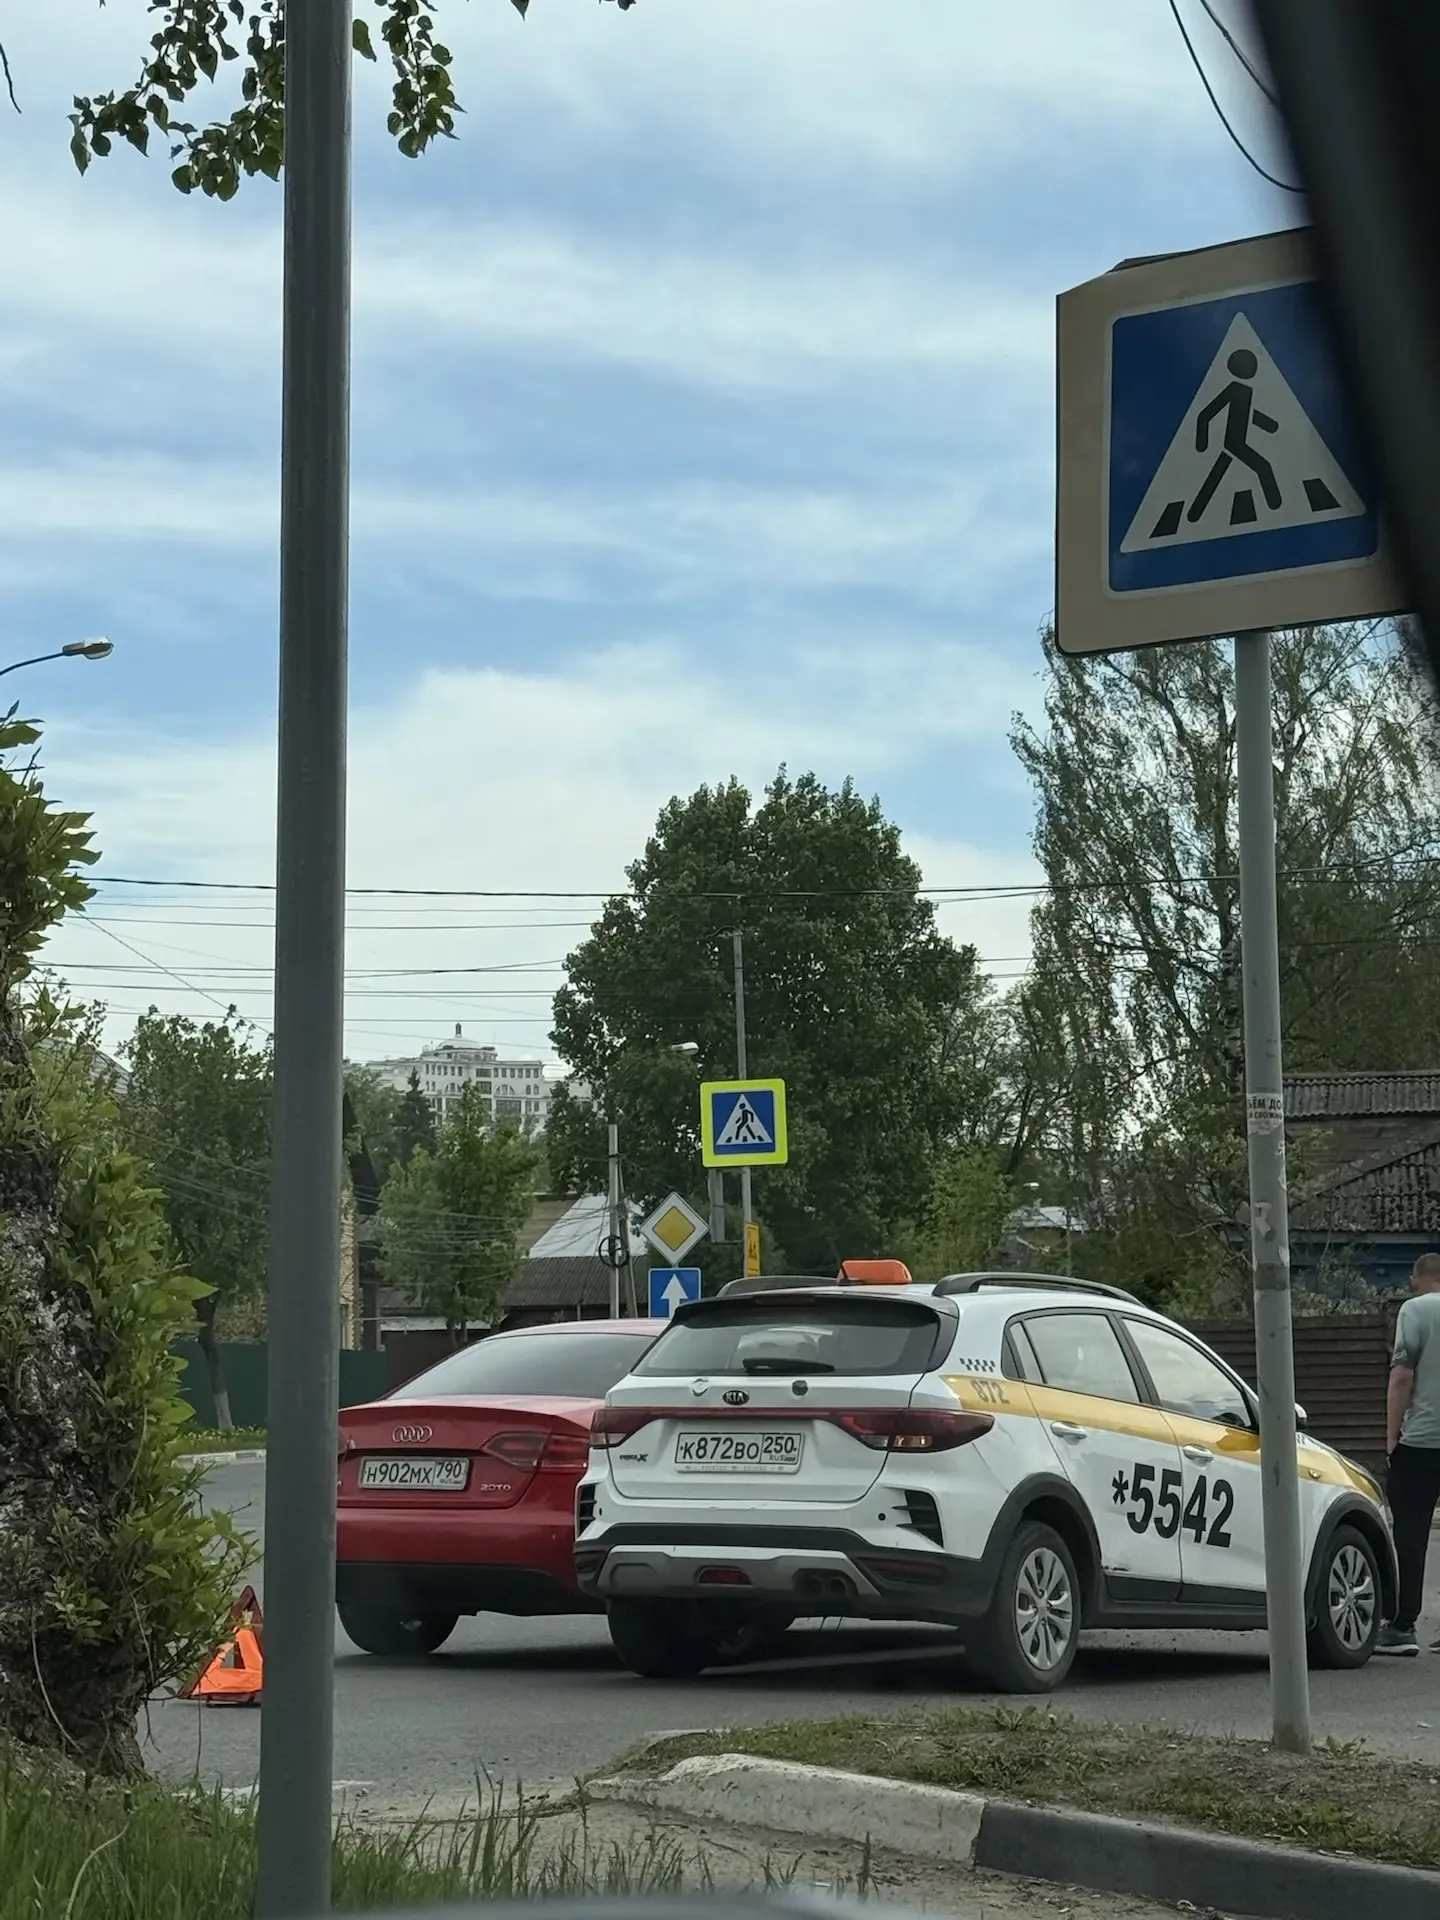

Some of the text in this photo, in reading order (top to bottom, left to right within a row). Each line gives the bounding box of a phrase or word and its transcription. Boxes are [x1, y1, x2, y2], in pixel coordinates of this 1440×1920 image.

[725, 1391, 745, 1402] KIA
[970, 1379, 1011, 1404] 872
[682, 1436, 795, 1460] К872ВО 250
[366, 1461, 462, 1484] Н902МХ 790
